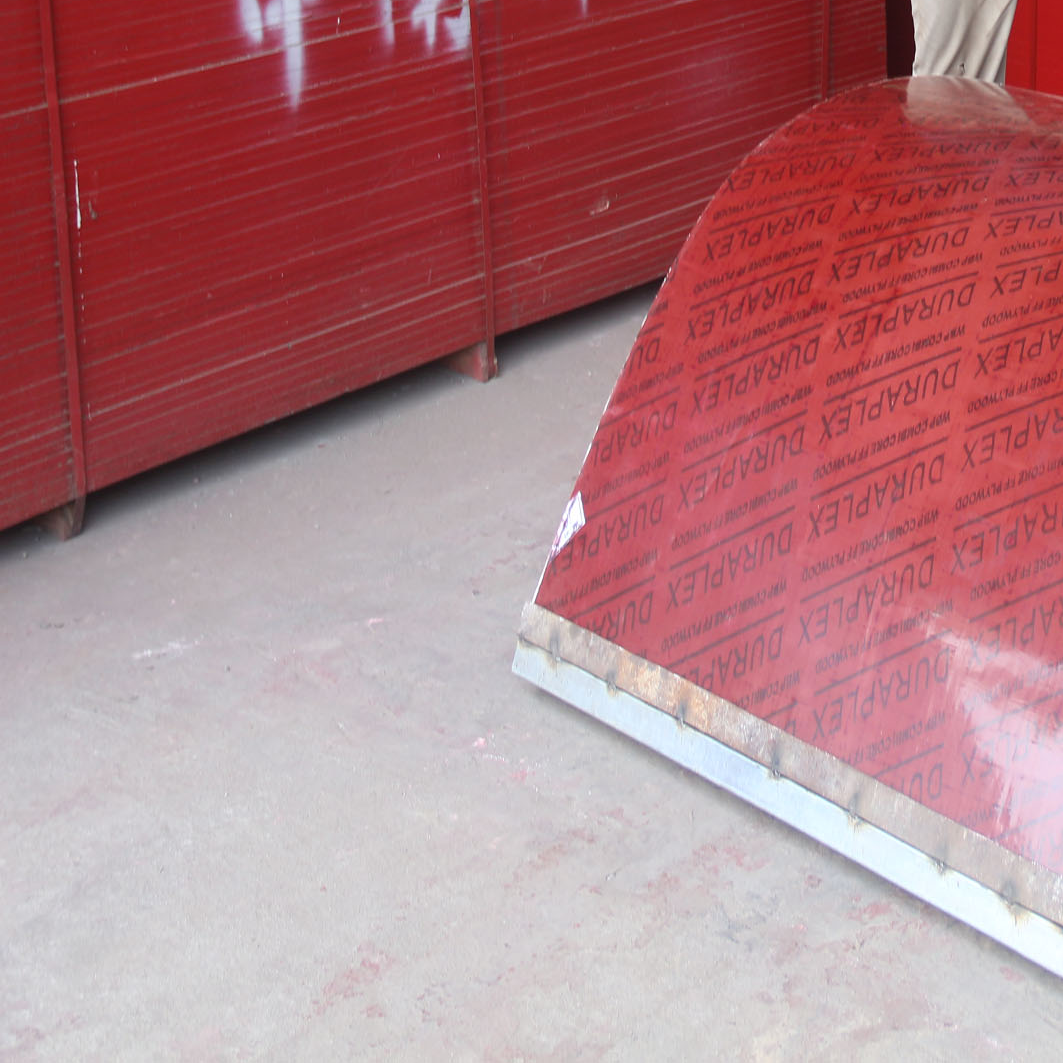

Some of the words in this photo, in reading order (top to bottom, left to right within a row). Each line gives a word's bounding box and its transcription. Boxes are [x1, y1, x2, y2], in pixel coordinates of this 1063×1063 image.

[703, 203, 836, 263] DURAPLEX
[849, 176, 990, 215] DURAPLEX
[827, 227, 971, 287] DURAPLEX
[685, 270, 815, 344] DURAPLEX
[834, 284, 975, 352] DURAPLEX
[692, 337, 820, 417] DURAPLEX
[819, 360, 959, 445] DURAPLEX
[592, 402, 678, 466] DURAPL
[679, 424, 805, 512] DURAPLEX
[808, 453, 944, 542] DURAPLEX
[668, 523, 792, 614] DURAPLEX
[798, 555, 933, 647] DURAPLEX
[813, 647, 949, 742] DURAPLEX
